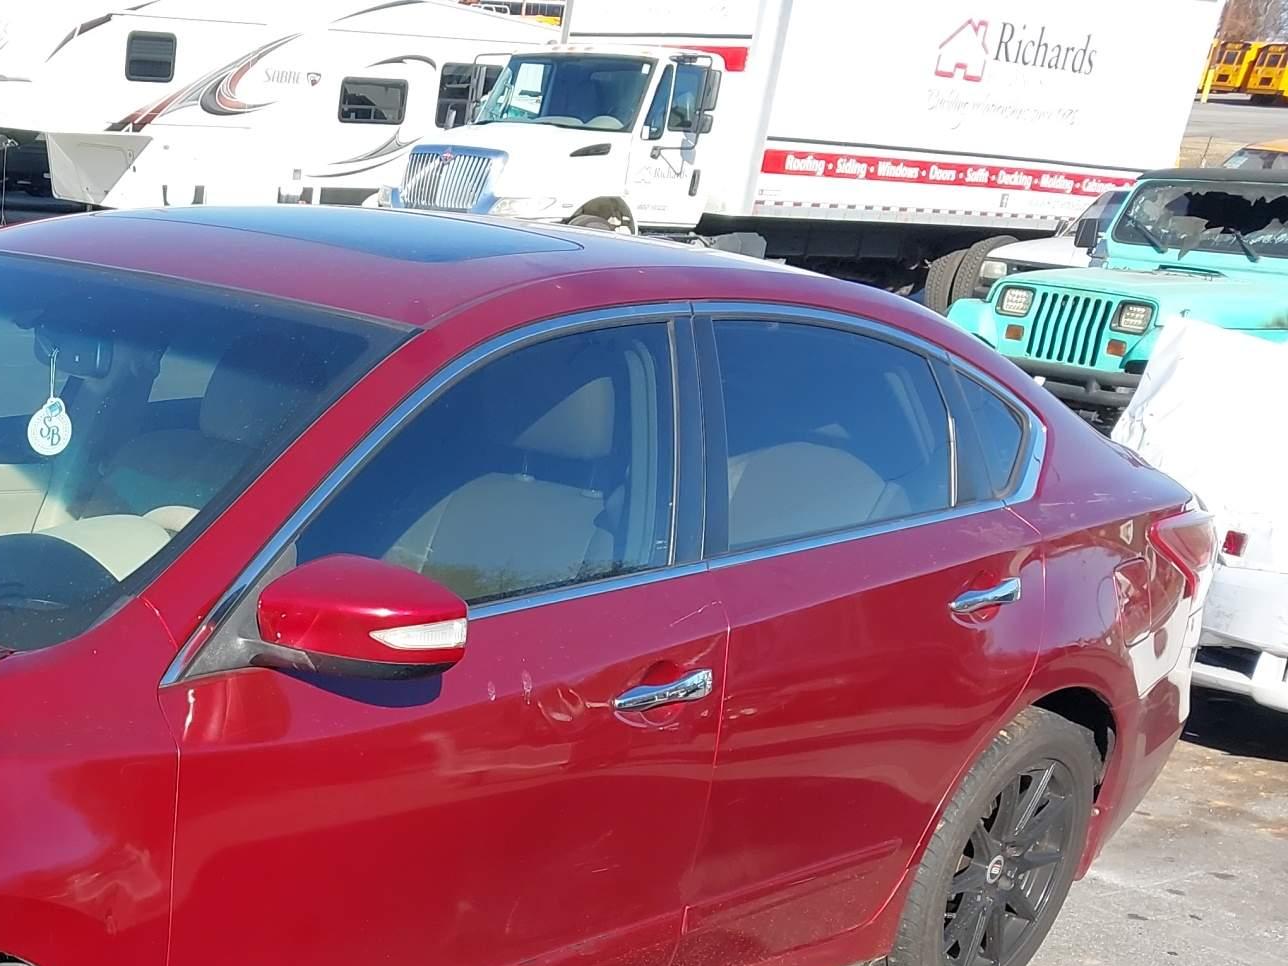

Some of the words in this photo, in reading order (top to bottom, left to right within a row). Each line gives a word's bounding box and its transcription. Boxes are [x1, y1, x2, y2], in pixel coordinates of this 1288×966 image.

[993, 21, 1098, 75] Richards
[785, 154, 826, 175] Roofing
[836, 158, 867, 179] Siding
[877, 161, 919, 179] Windows
[929, 165, 957, 182] Doors
[998, 170, 1033, 189] Decking
[1040, 174, 1074, 193] Molding
